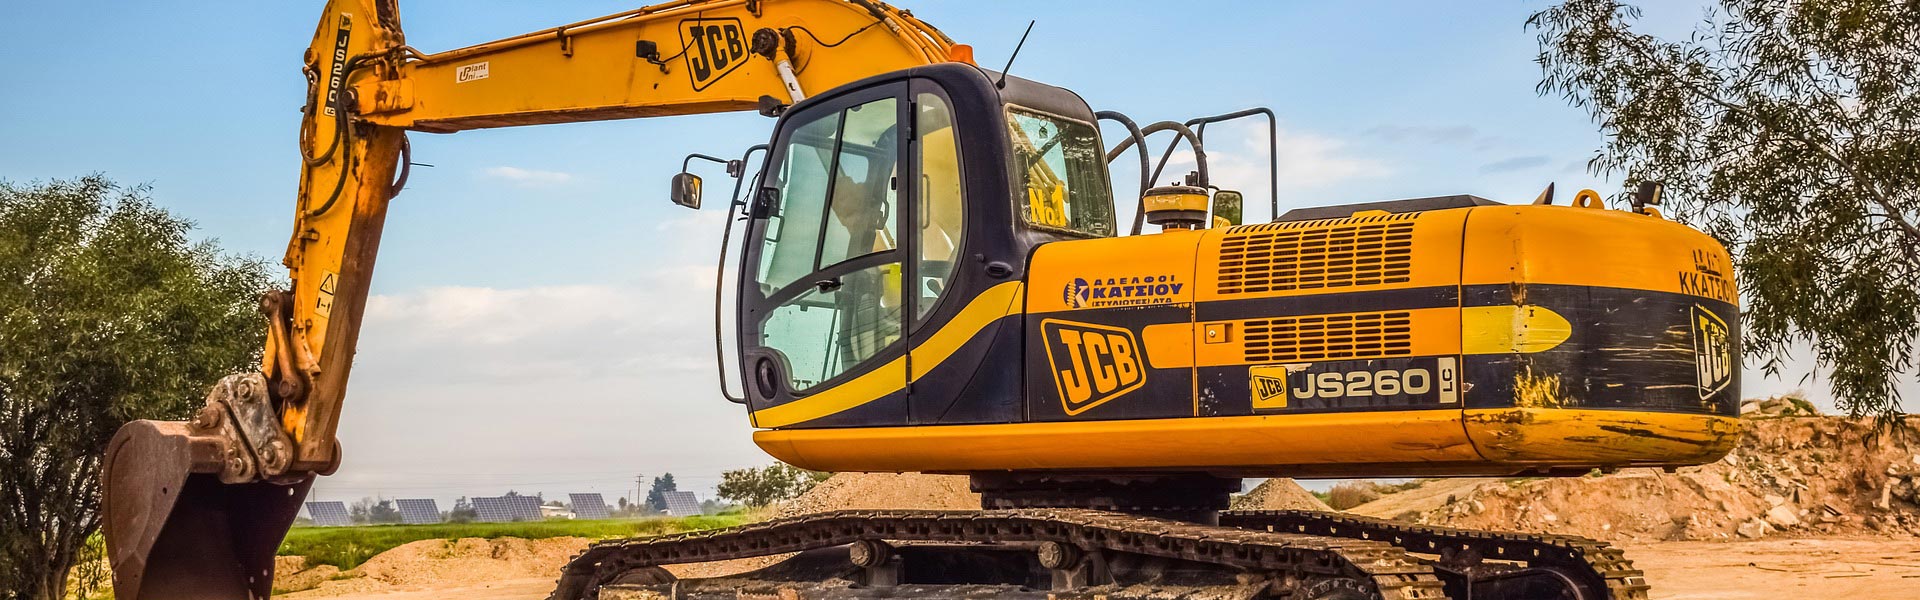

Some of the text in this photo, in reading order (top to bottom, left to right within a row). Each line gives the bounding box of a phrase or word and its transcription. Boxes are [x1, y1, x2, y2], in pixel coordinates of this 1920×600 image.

[690, 24, 743, 82] JCB
[1092, 282, 1184, 299] ΚΑΤΣΙΟΥ
[1059, 328, 1139, 404] JCB
[1698, 314, 1730, 388] JCB
[1259, 367, 1453, 399] JCB JS260 LC
